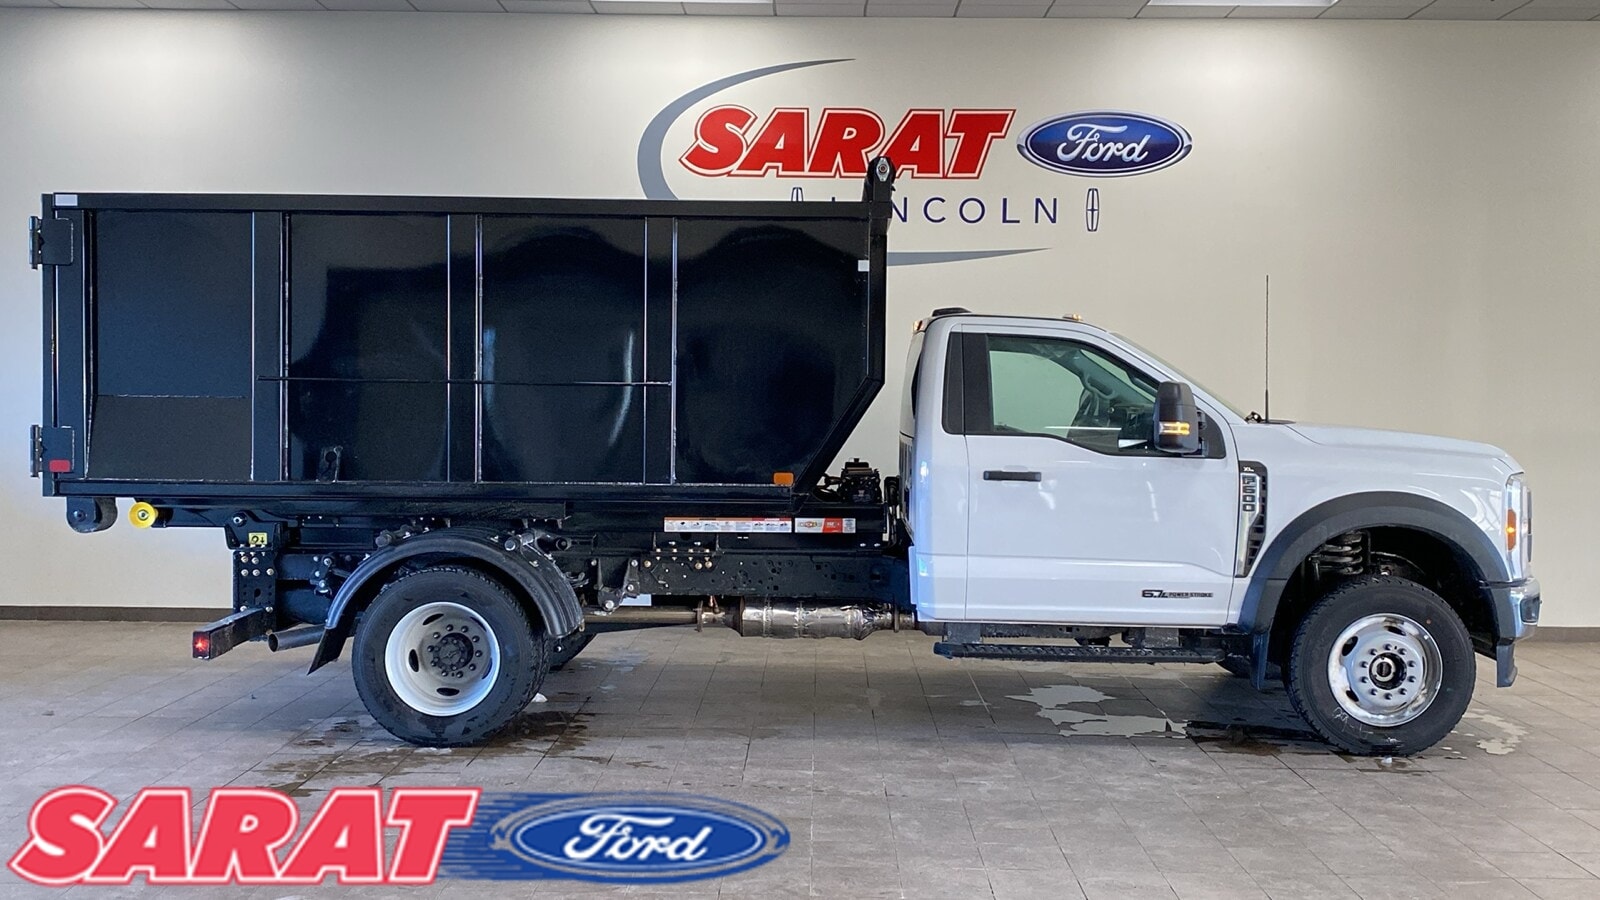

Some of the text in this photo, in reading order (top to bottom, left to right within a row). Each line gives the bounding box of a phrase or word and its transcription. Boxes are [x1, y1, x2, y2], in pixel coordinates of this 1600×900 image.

[679, 104, 1017, 179] SARAT
[1056, 123, 1151, 162] Ford
[831, 197, 1058, 224] NCOLN
